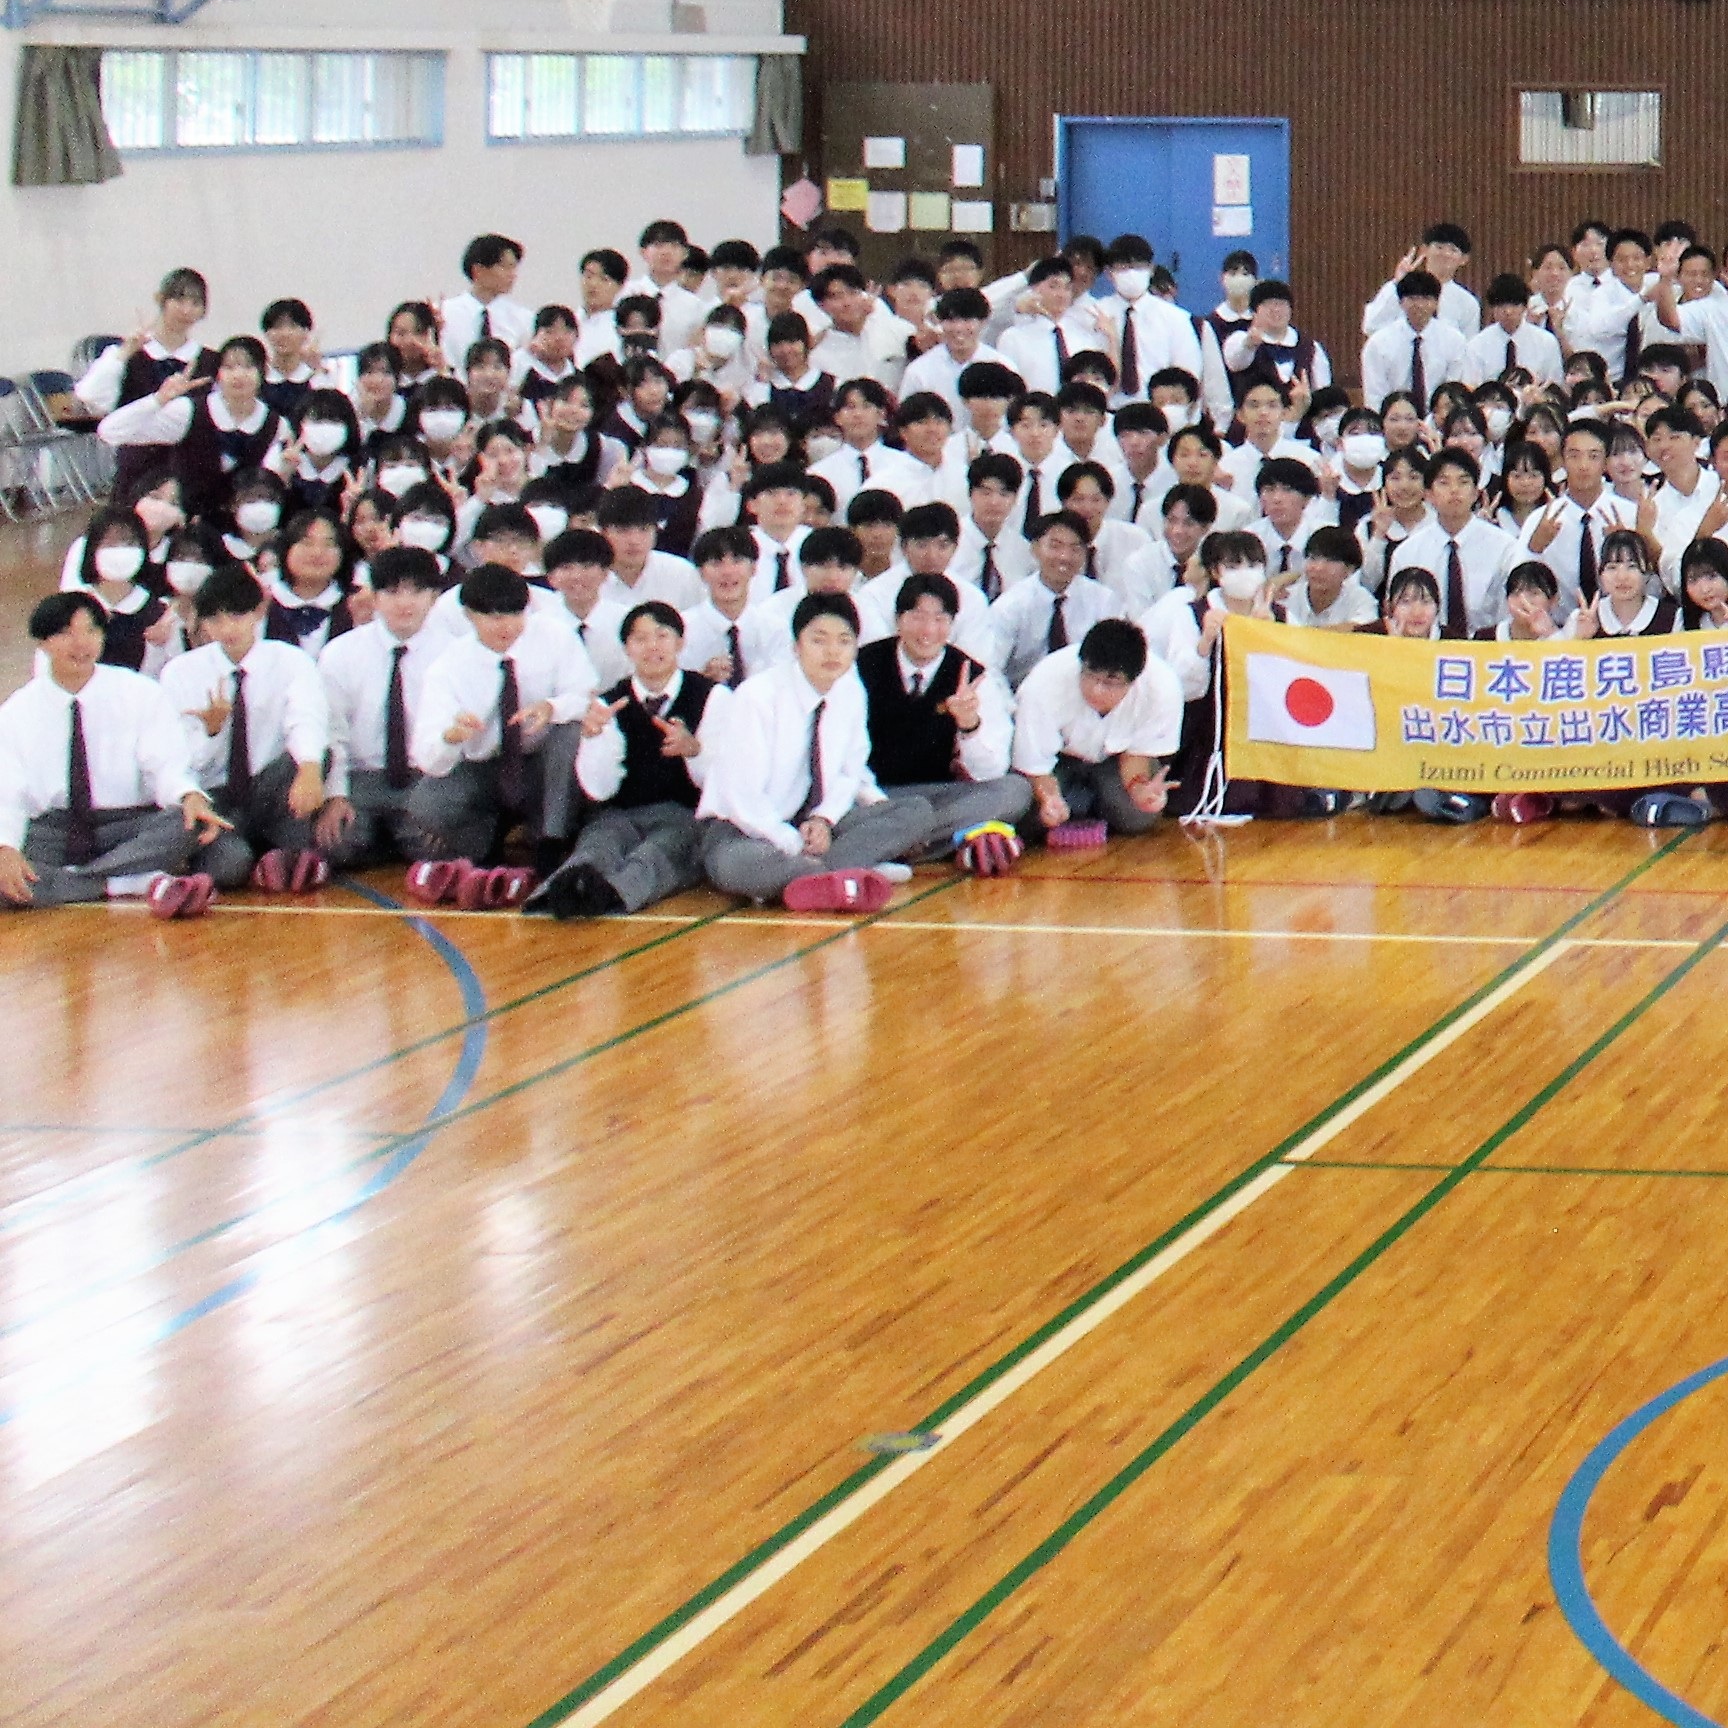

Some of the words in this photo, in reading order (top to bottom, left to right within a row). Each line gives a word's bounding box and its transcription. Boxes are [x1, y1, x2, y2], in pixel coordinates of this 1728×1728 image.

[1419, 761, 1486, 782] Izumi
[1494, 760, 1635, 782] Commercial
[1643, 757, 1702, 778] High
